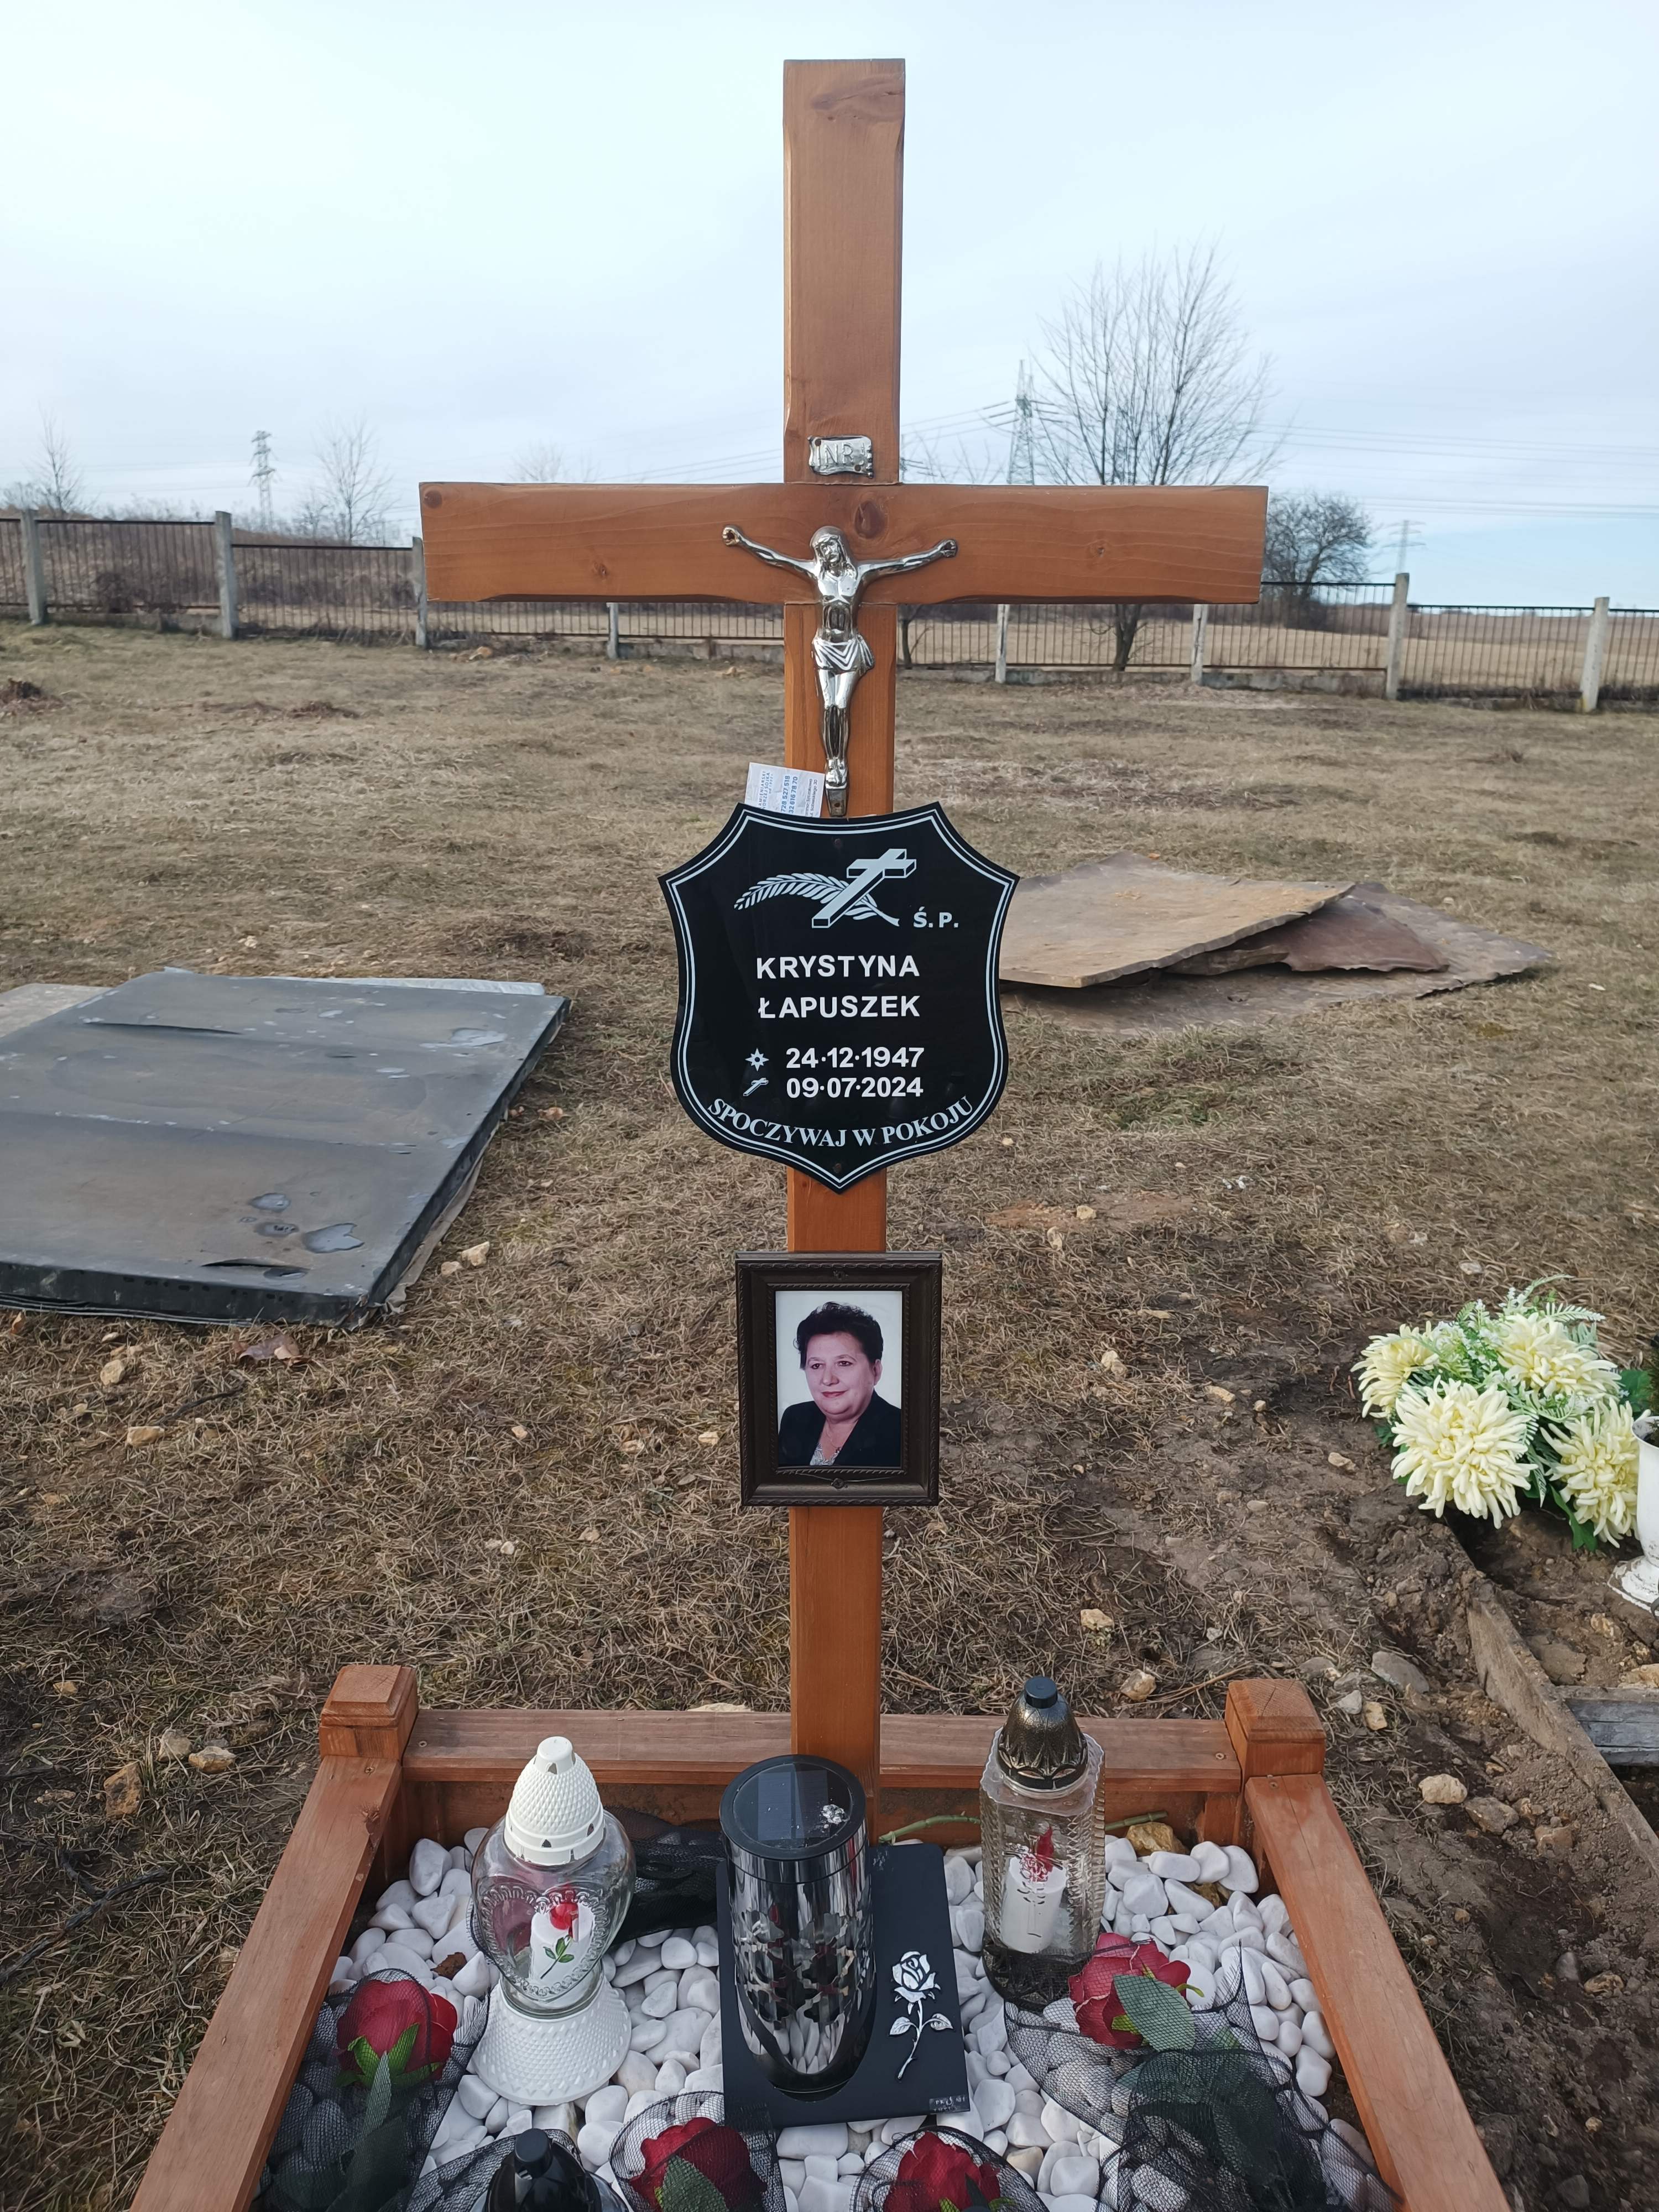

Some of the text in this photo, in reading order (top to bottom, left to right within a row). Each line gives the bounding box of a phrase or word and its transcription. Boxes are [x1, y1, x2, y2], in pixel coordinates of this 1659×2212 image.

[789, 805, 795, 813] 32
[757, 954, 920, 979] KRYSTYNA
[758, 995, 920, 1019] ŁAPUSZEK
[707, 1095, 973, 1147] SPOCZYWAJ W POKOJU
